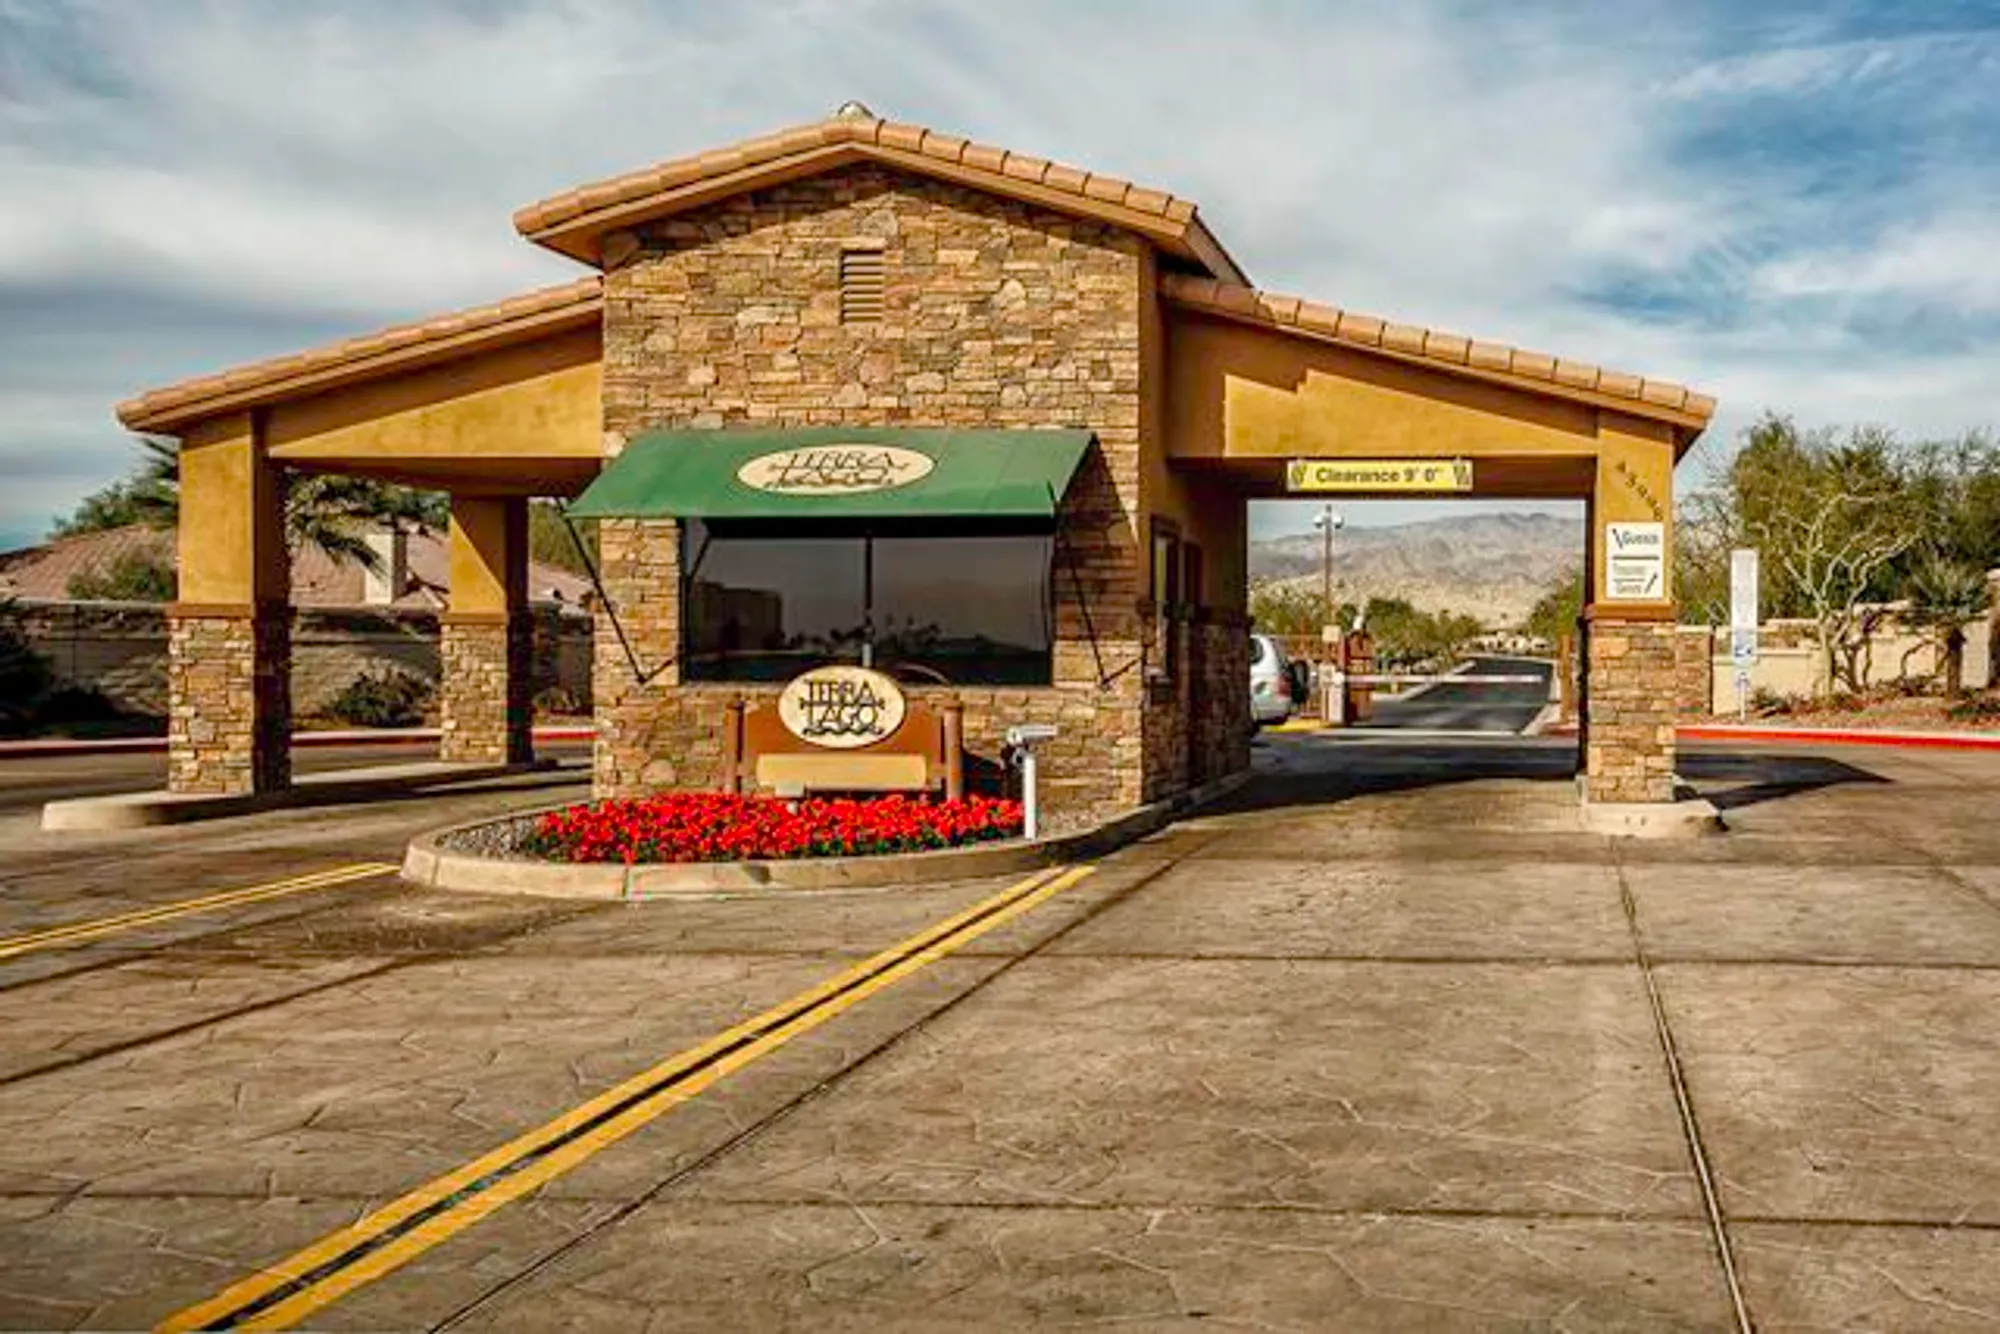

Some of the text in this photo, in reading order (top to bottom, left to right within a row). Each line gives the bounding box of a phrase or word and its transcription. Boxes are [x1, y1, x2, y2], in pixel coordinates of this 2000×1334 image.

[1315, 466, 1400, 483] Clearance
[1403, 466, 1420, 483] 9'
[807, 700, 879, 728] LAGO
